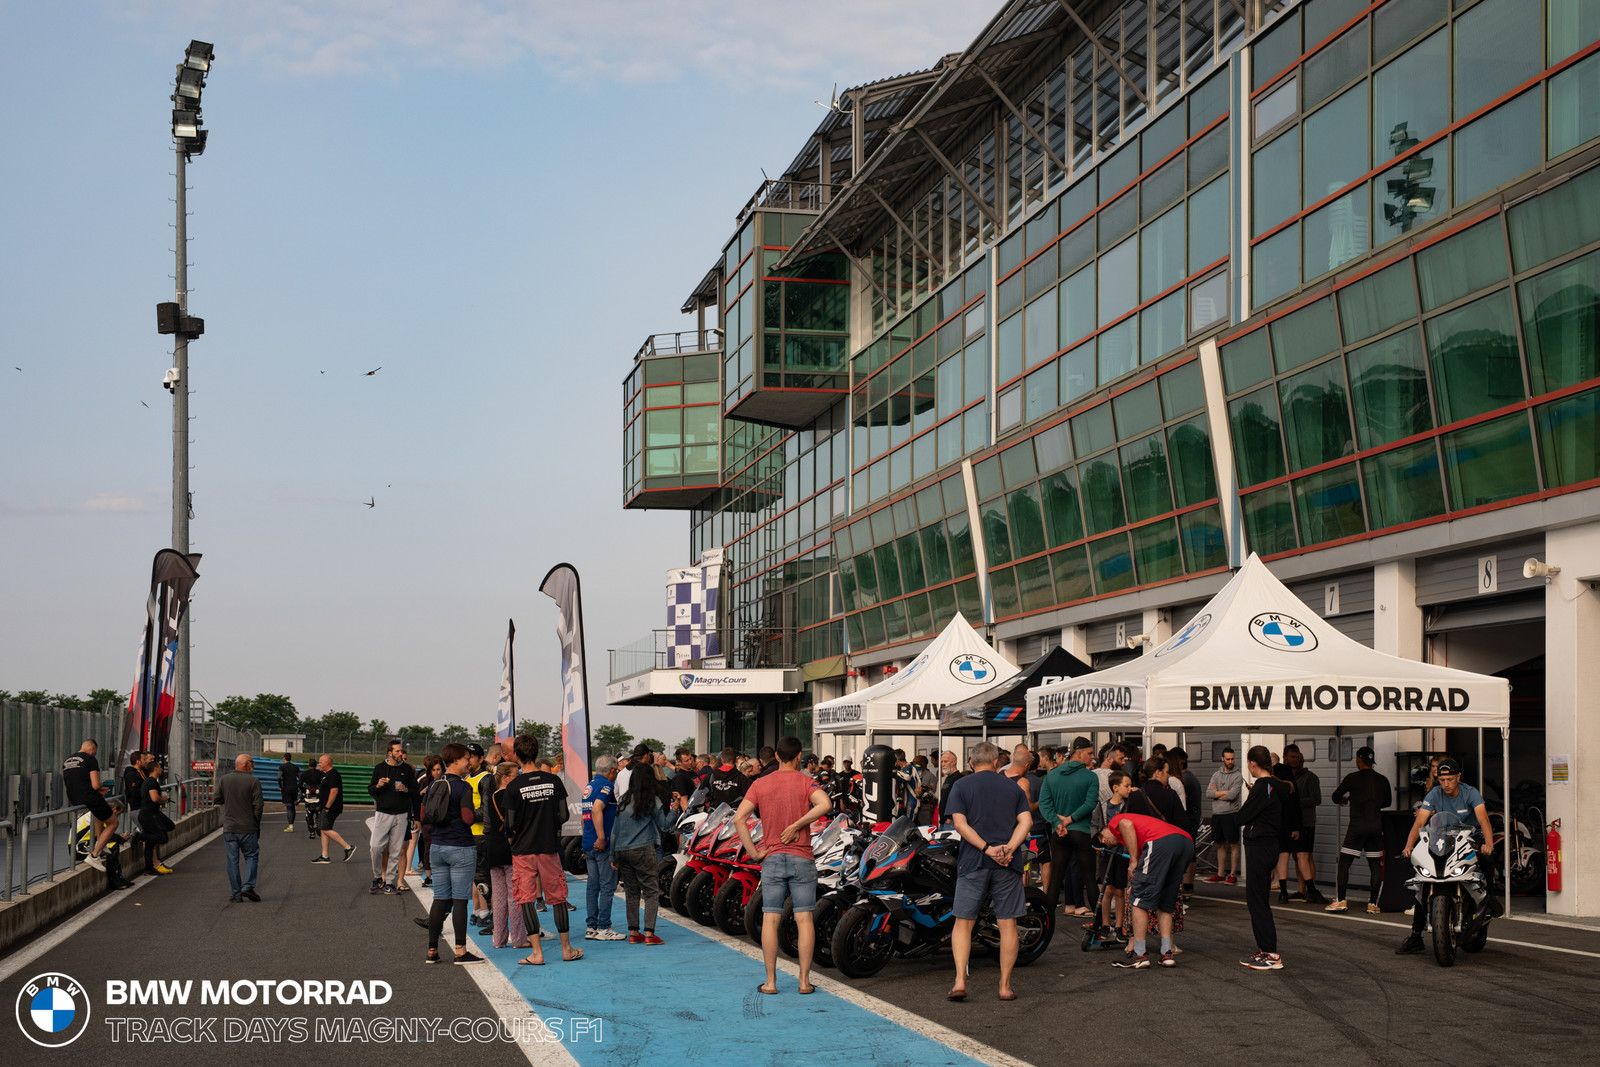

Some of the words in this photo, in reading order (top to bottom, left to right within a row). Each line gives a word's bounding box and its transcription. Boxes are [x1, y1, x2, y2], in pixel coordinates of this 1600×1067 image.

[1483, 560, 1492, 589] 8
[1329, 586, 1335, 611] 7
[1254, 615, 1301, 628] BMW
[954, 656, 987, 665] BMW
[695, 677, 747, 685] Magny-Cours
[1038, 692, 1066, 717] BMW
[1067, 686, 1132, 714] MOTORRAD
[1190, 686, 1273, 710] BMW
[1285, 685, 1470, 712] MOTORRAD
[832, 704, 861, 722] MOTORRAD
[522, 789, 554, 800] FINISHER
[872, 842, 888, 857] 2
